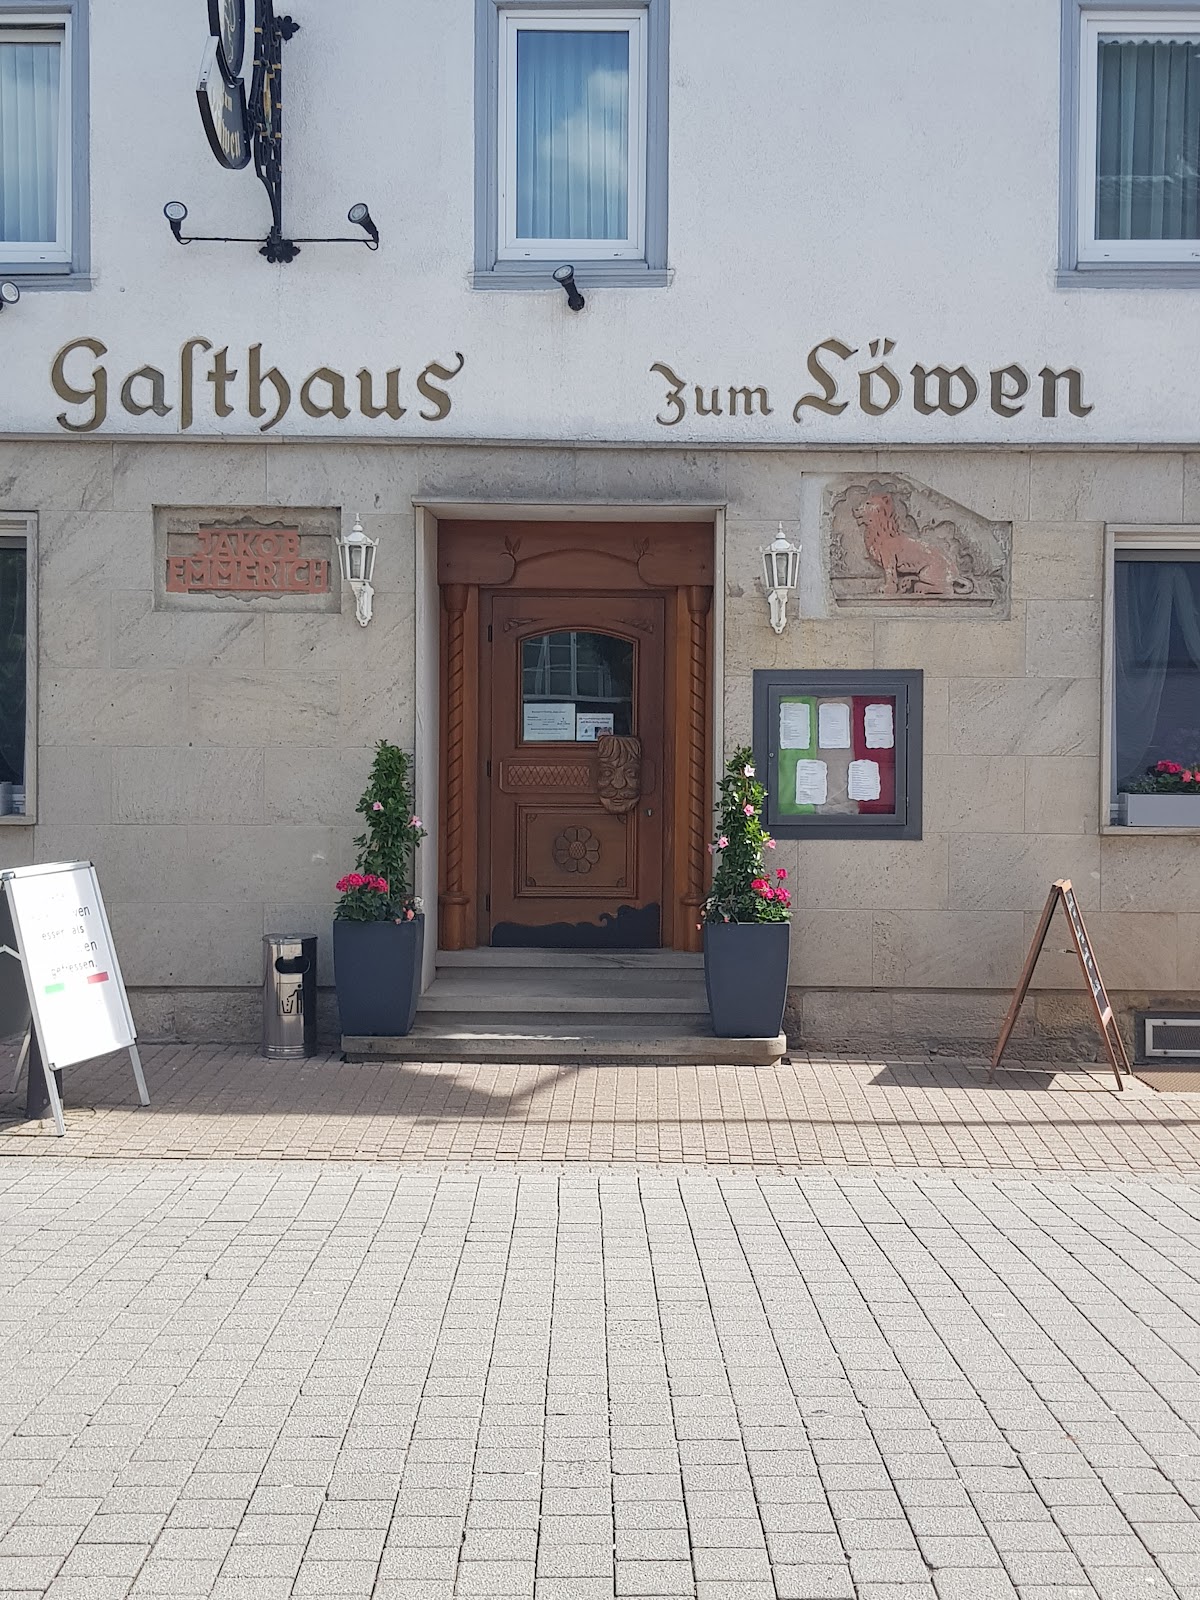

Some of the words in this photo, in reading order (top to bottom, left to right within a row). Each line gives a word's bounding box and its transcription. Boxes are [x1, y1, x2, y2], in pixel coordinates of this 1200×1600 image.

[792, 337, 1095, 423] Löwen
[195, 529, 300, 558] JAKOB
[168, 558, 328, 591] EMMERICH
